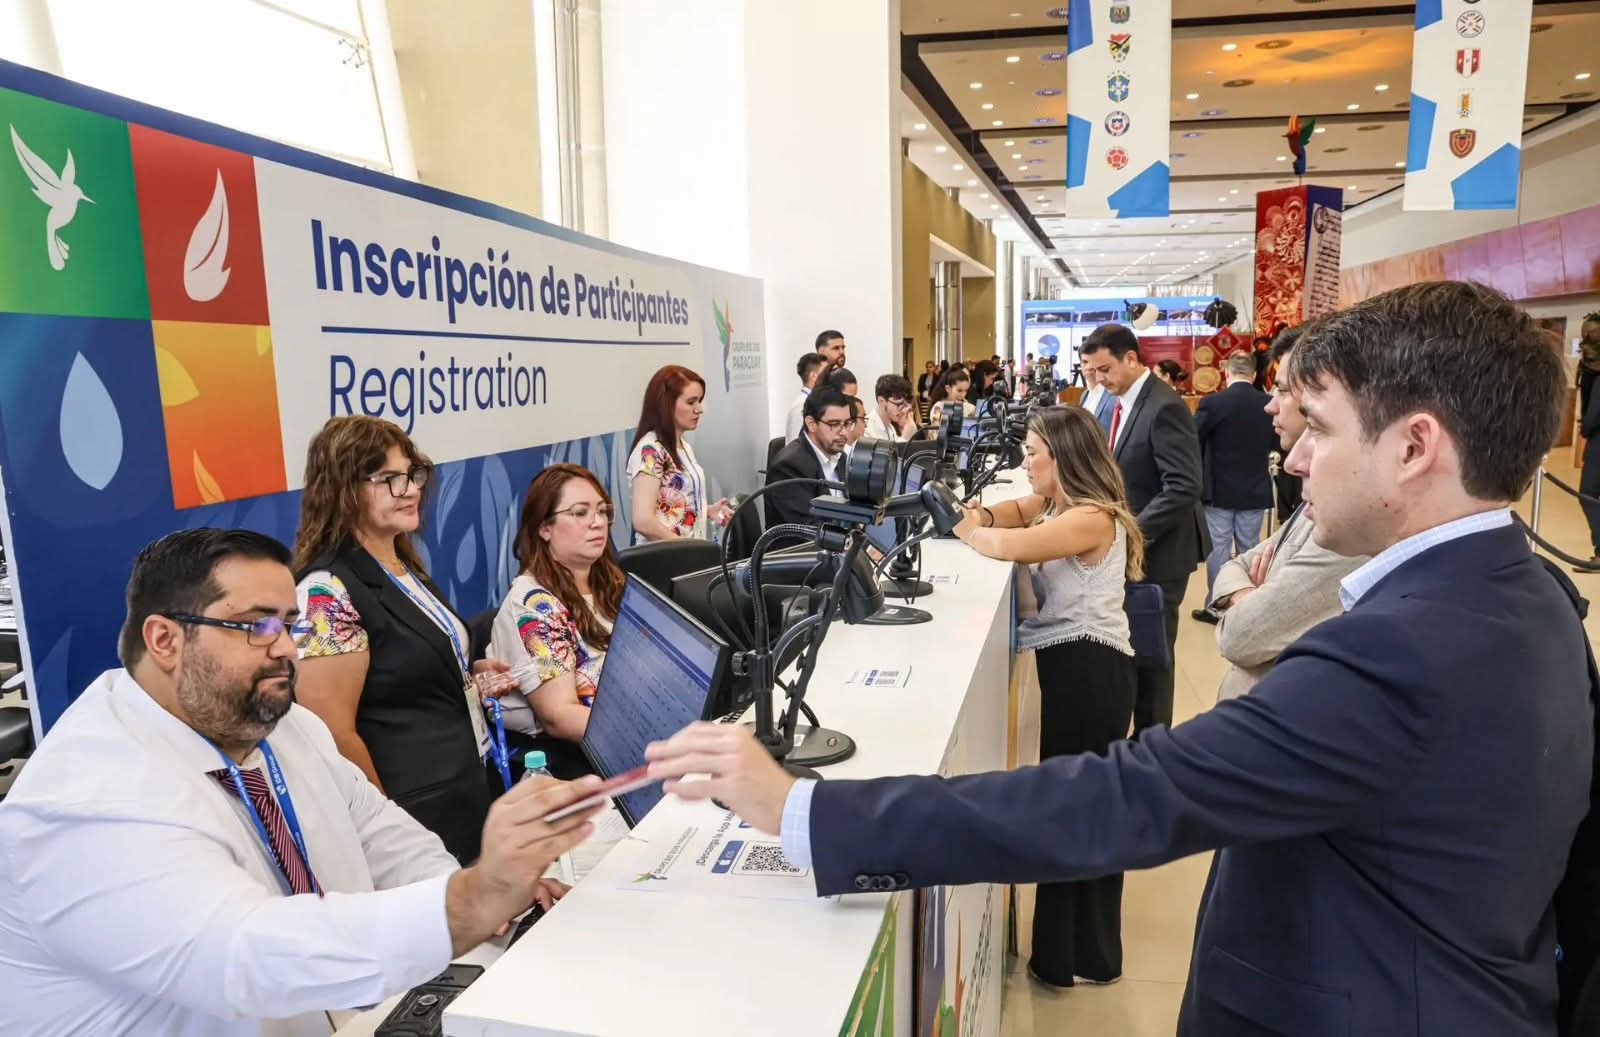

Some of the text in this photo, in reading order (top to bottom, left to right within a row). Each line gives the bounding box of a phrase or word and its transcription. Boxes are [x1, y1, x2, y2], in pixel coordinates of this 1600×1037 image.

[311, 218, 689, 337] Inscripción de Participantes
[330, 350, 547, 436] Registration
